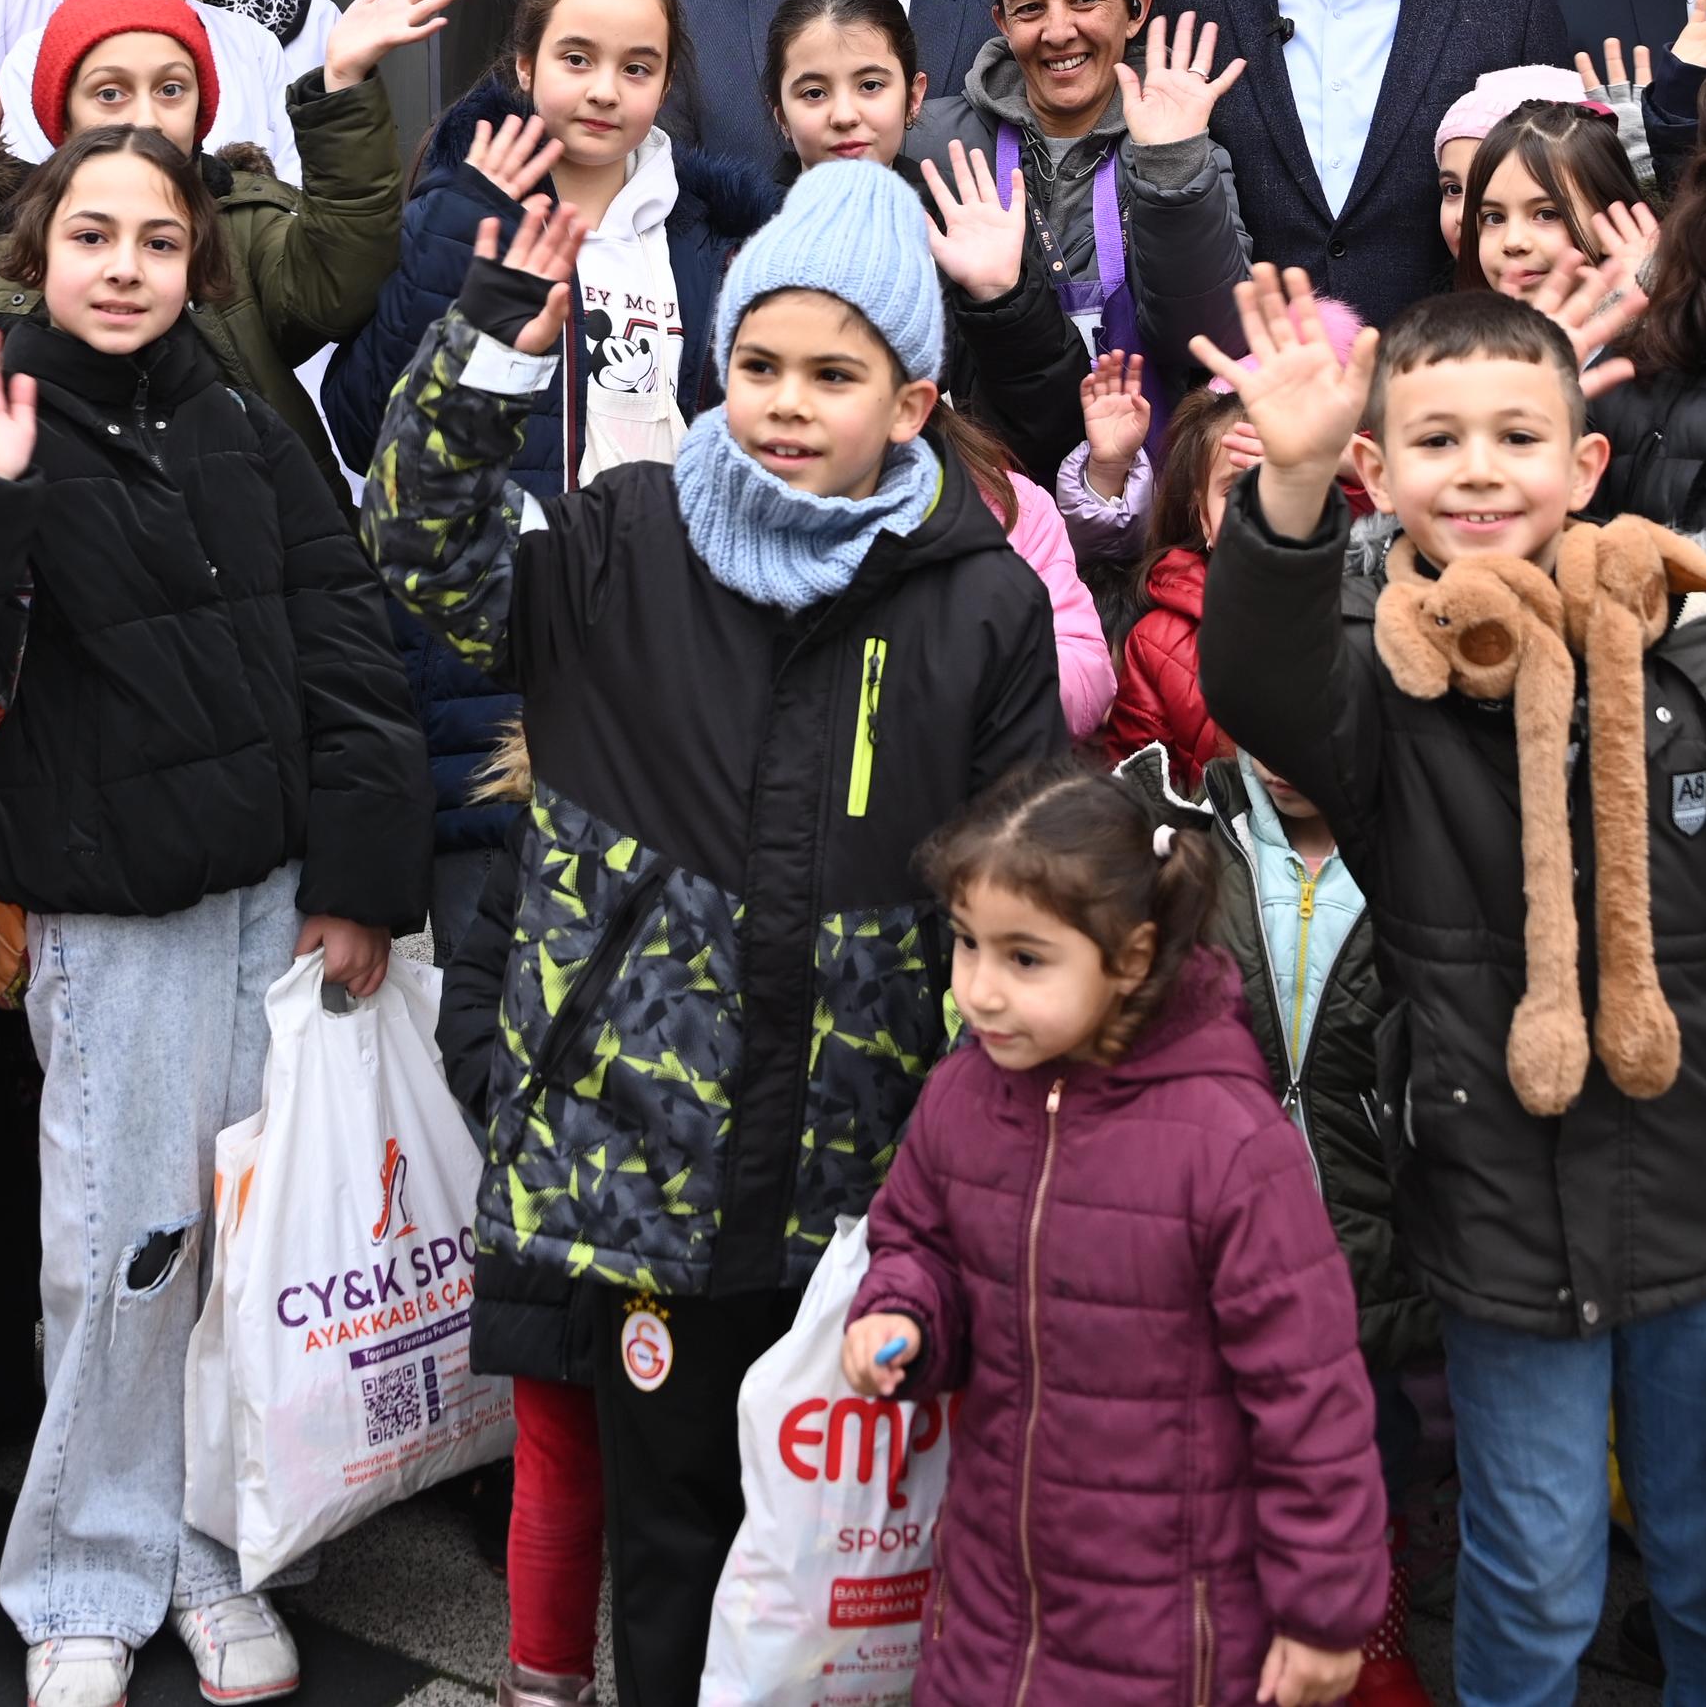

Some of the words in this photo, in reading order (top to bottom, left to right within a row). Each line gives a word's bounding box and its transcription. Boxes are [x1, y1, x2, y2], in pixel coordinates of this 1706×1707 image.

[277, 1257, 405, 1327] CY&K
[410, 1227, 477, 1288] SPO
[304, 1298, 424, 1353] AYAKKABI
[434, 1313, 470, 1337] Perakend
[836, 1524, 921, 1553] SPOR
[834, 1577, 925, 1601] BAY-BAYAN
[836, 1597, 917, 1620] EŞOFMAN
